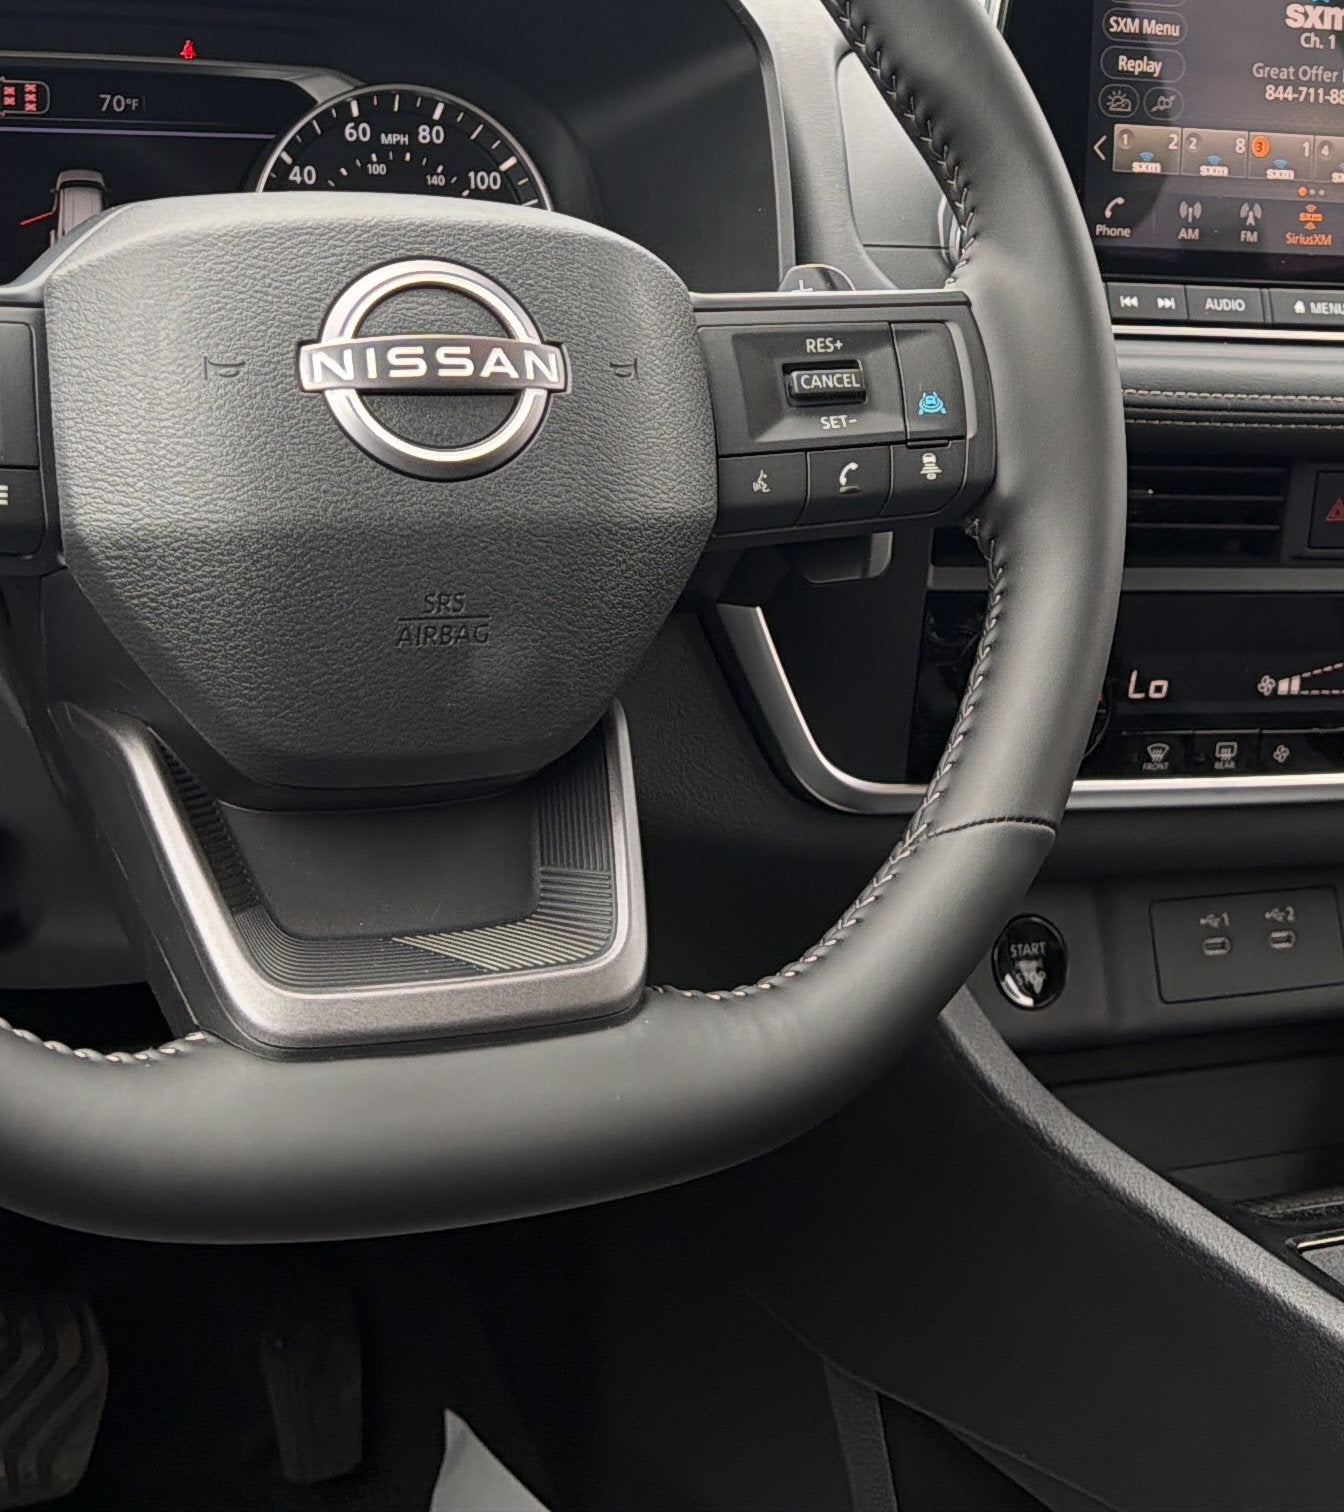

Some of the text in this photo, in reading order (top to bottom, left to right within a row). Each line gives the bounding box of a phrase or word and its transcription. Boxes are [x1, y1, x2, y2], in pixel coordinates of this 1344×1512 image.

[1109, 15, 1181, 37] SXM Menu
[1300, 32, 1336, 50] Ch. 1
[1117, 55, 1163, 78] Replay
[1252, 62, 1296, 81] Great
[1298, 65, 1338, 83] Offer
[98, 93, 141, 114] 70°F
[343, 122, 372, 143] 60
[380, 131, 409, 146] MPH
[417, 124, 446, 145] 80
[1122, 133, 1179, 151] 1 2
[1188, 137, 1246, 154] 2 8
[1302, 141, 1310, 158] 1
[1320, 144, 1330, 157] 4
[288, 165, 317, 186] 40
[366, 162, 388, 176] 100
[425, 173, 446, 187] 140
[467, 170, 503, 191] 100
[1095, 223, 1132, 238] Phone
[1177, 227, 1200, 241] AM
[1240, 230, 1259, 244] FM
[1285, 232, 1333, 247] SiriusXM
[1205, 297, 1246, 312] AUDIO
[805, 337, 844, 354] RES+
[311, 345, 560, 384] NISSAN
[800, 373, 861, 390] CANCEL
[422, 592, 466, 615] SRS
[394, 623, 492, 650] AIRBAG
[1127, 670, 1169, 700] Lo
[1141, 761, 1170, 772] FRONT
[1213, 759, 1237, 770] REAR
[1222, 911, 1230, 927] 1
[1285, 905, 1295, 922] 2
[1009, 941, 1047, 959] START
[1015, 970, 1047, 988] STOP
